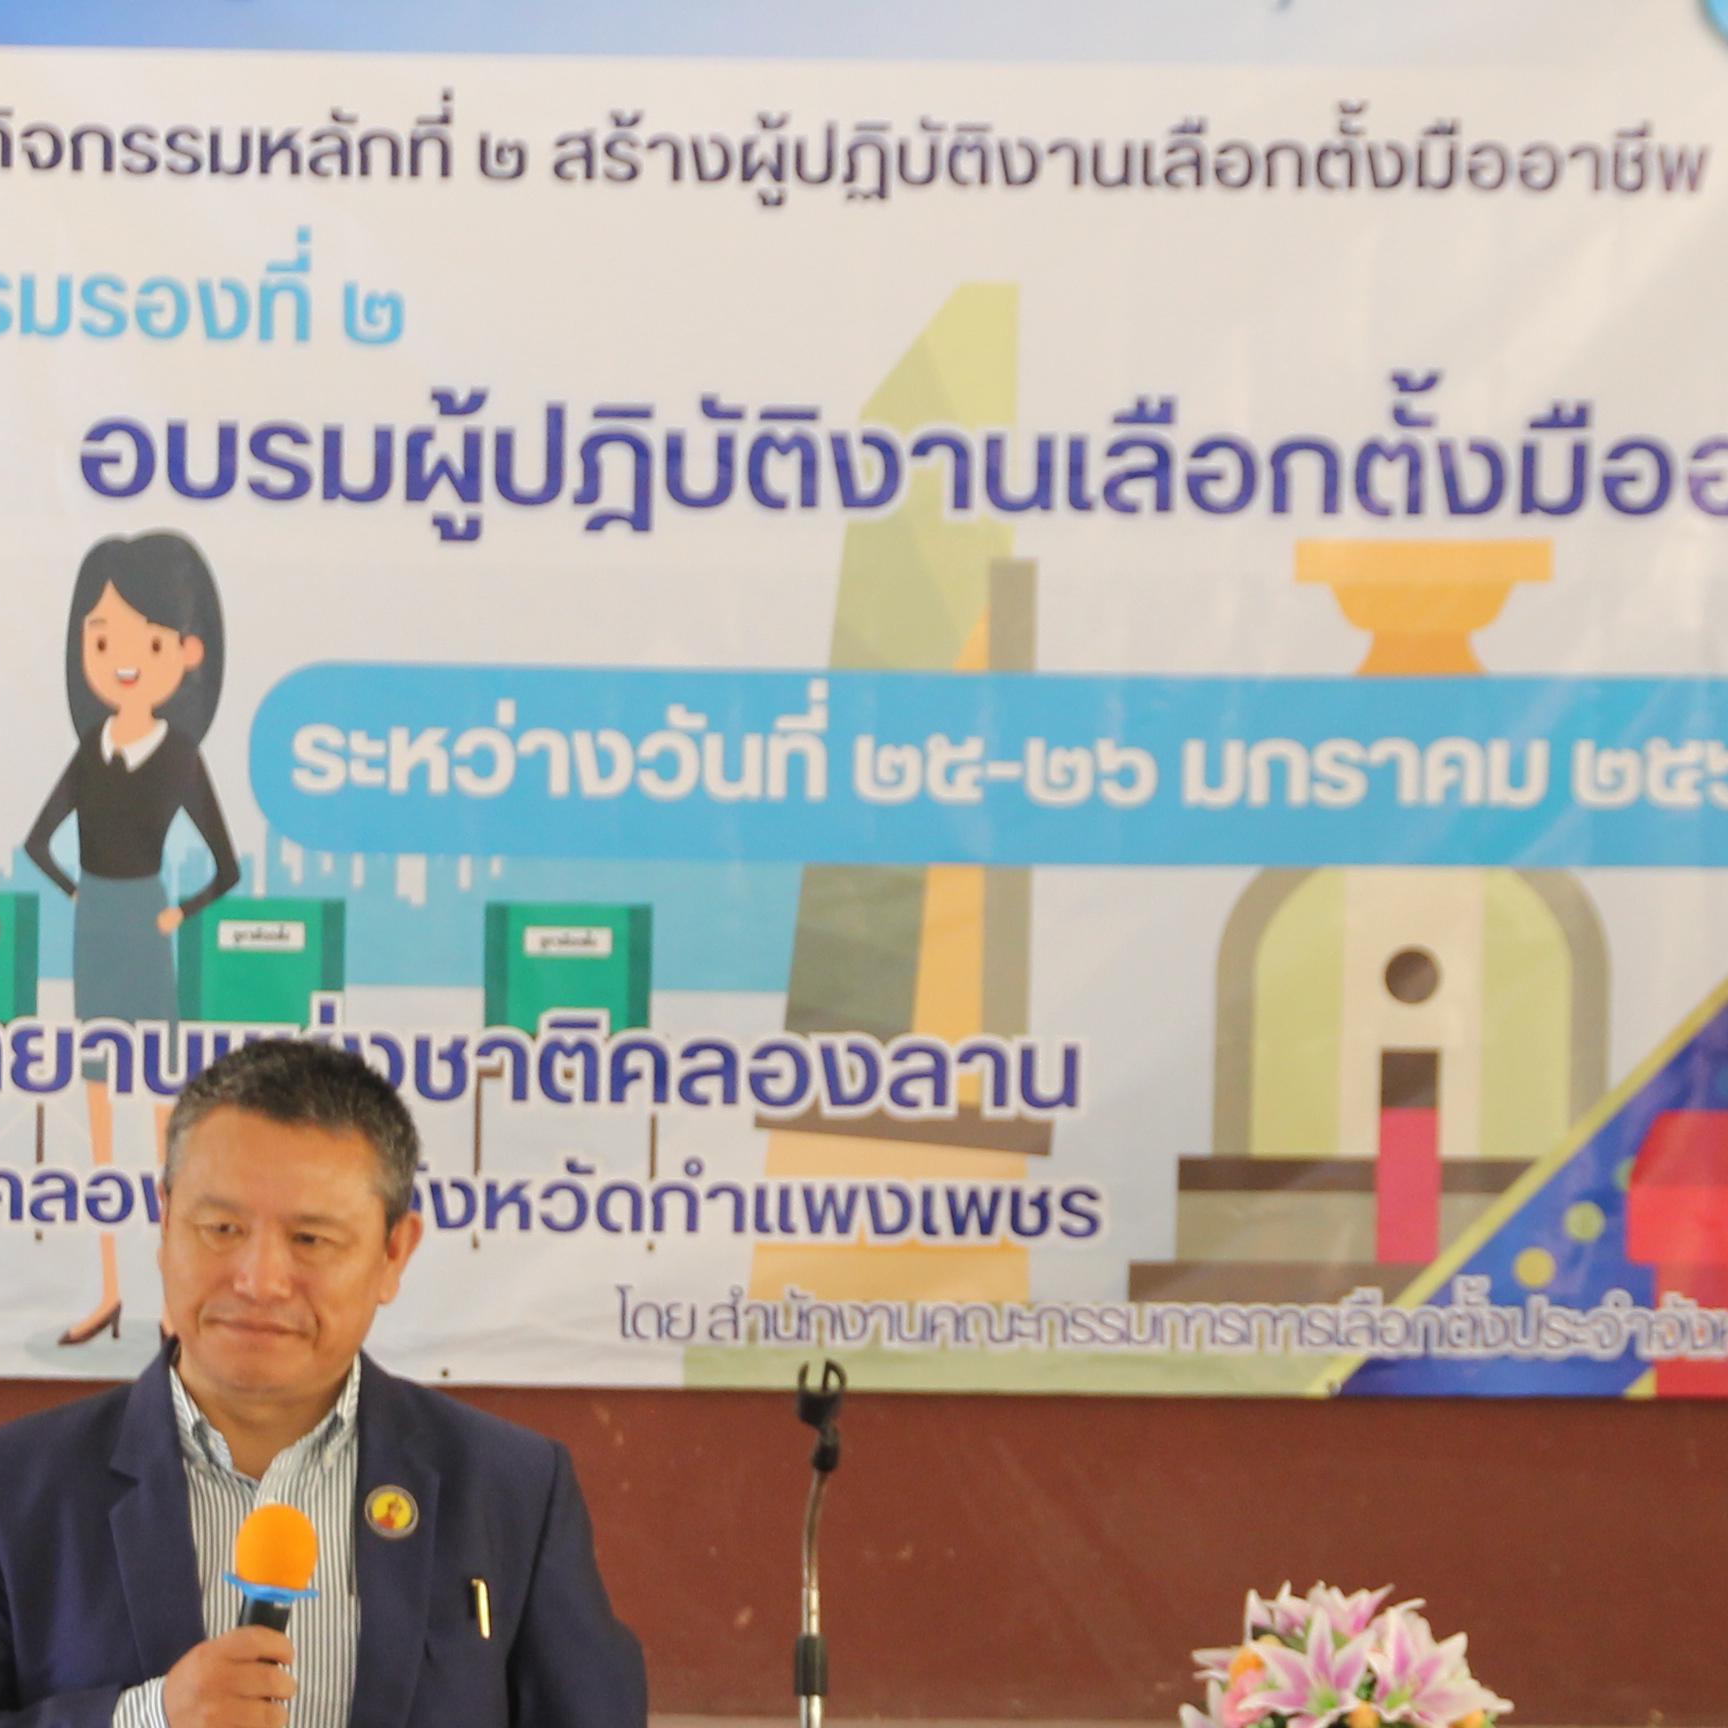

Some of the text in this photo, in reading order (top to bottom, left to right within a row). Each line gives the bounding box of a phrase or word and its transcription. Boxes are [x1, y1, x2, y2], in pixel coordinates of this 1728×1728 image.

[478, 134, 526, 184] ๒
[344, 281, 404, 344] ๒
[290, 683, 830, 802] ระหว่างวันที่
[854, 728, 1158, 808] ๒๕-๒๖
[1183, 737, 1549, 810] มกราคม
[618, 1286, 693, 1342] โดย
